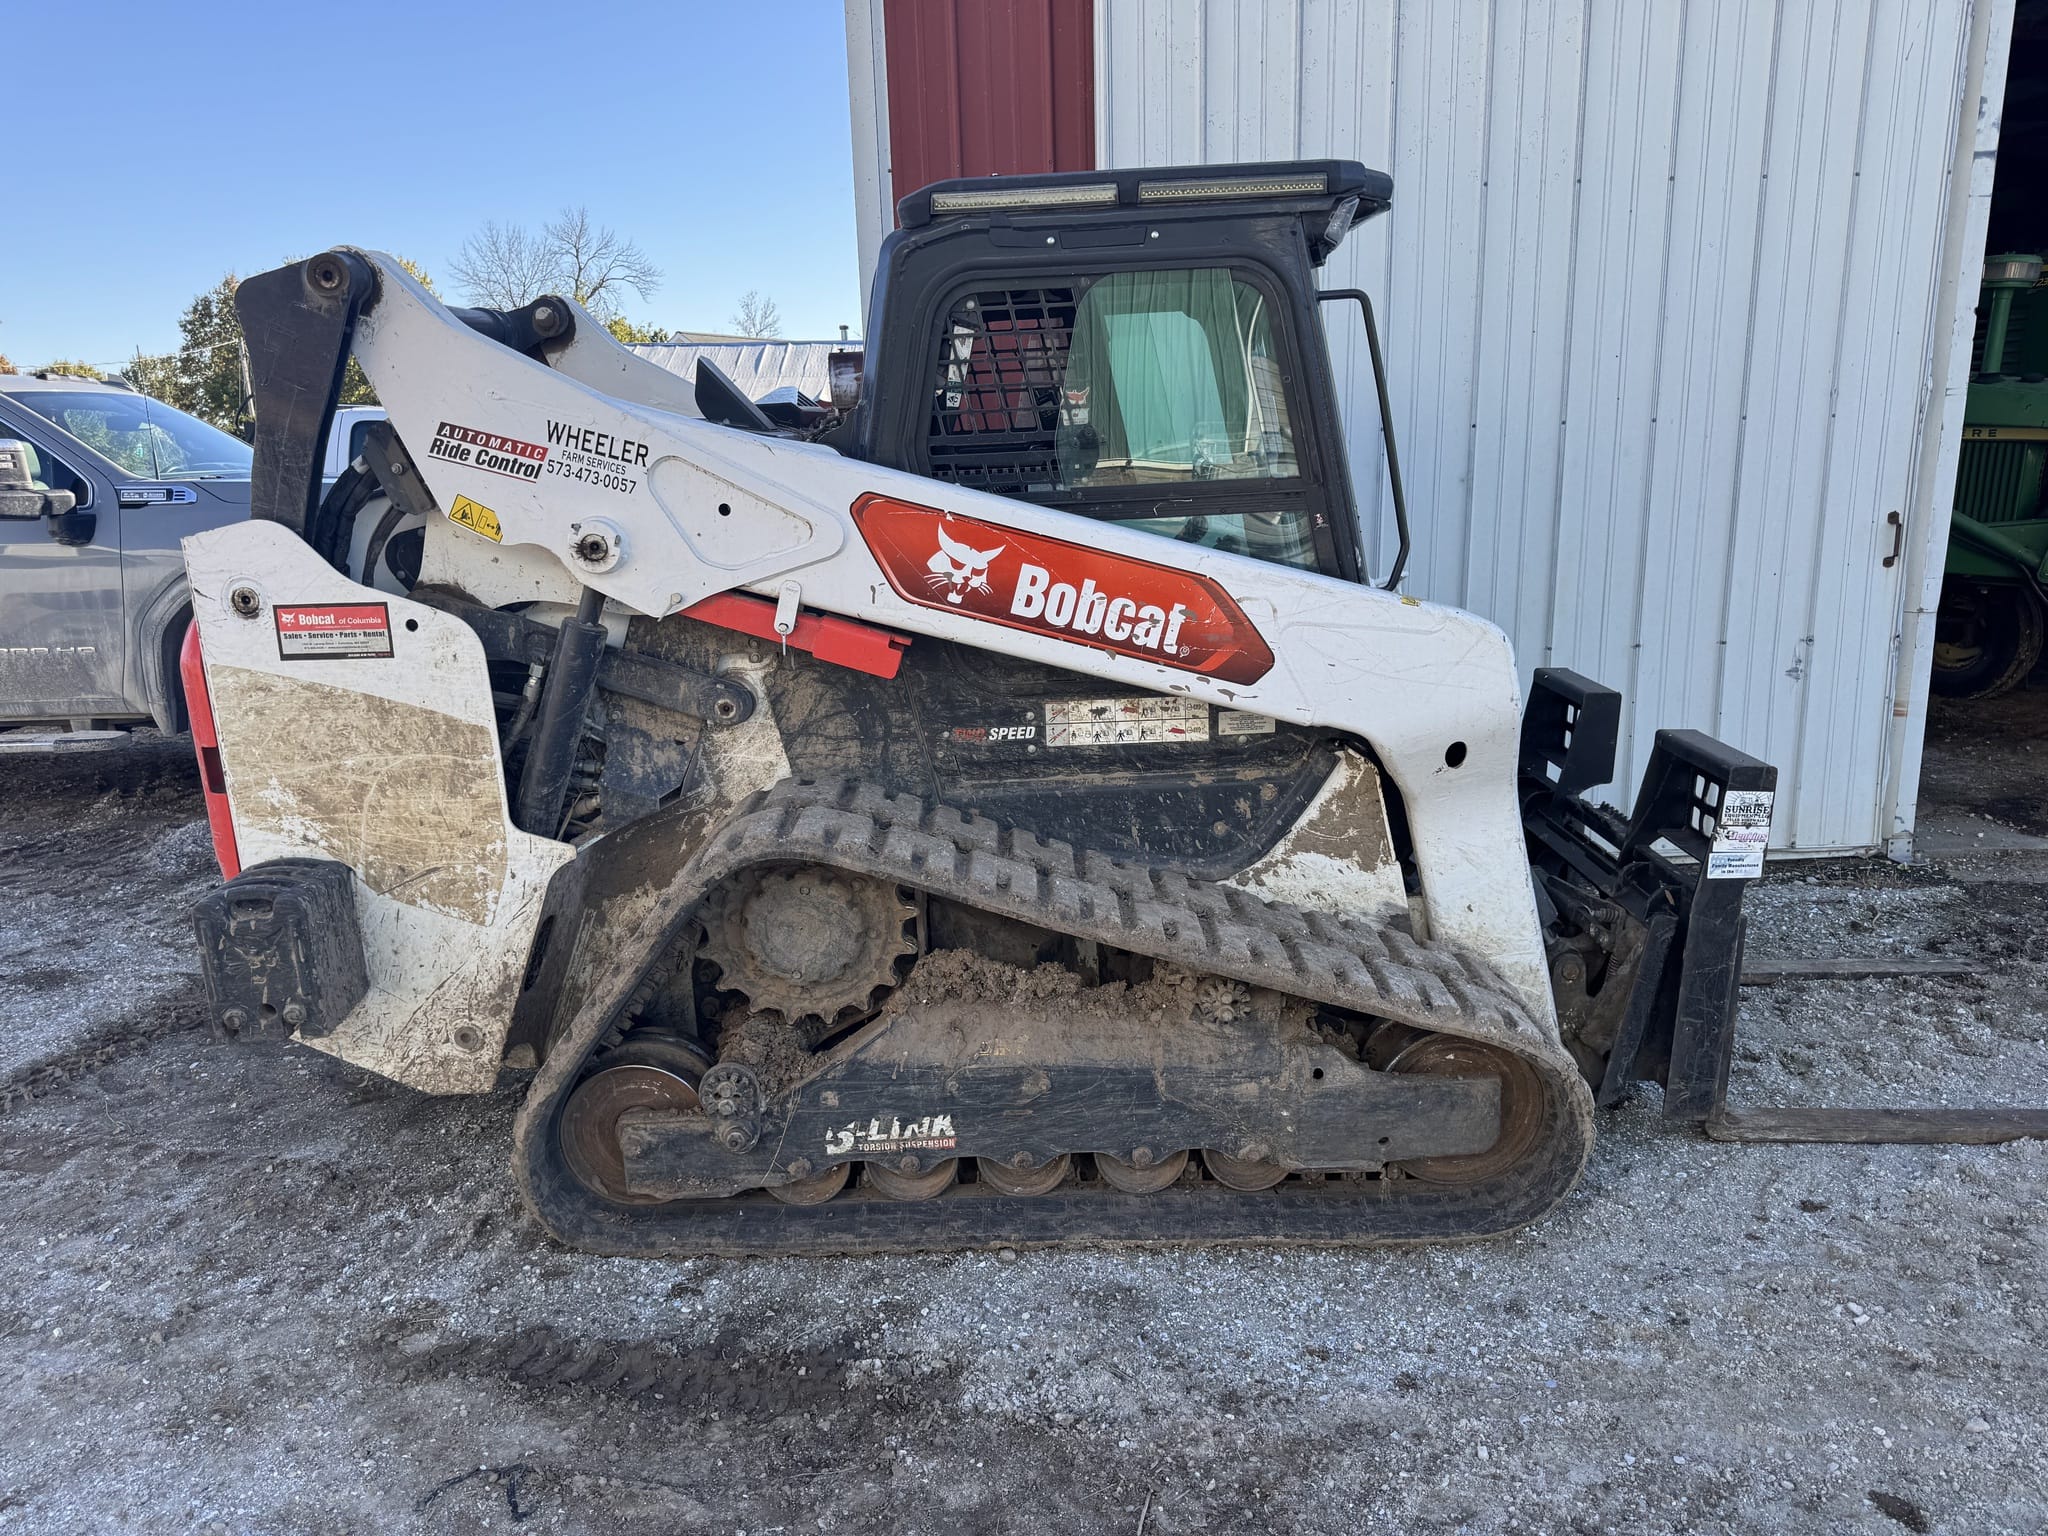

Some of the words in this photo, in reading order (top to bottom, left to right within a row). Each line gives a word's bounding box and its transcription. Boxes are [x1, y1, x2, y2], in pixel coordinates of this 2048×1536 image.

[440, 424, 544, 459] AUTOMATIC
[547, 420, 649, 467] WHEELER
[429, 437, 470, 462] Ride
[475, 449, 543, 479] Control
[561, 450, 585, 464] FARM
[586, 456, 627, 475] SERVICES
[546, 459, 637, 494] 573-473-0057
[298, 613, 336, 625] Bobcat
[347, 616, 382, 624] Columbia
[1010, 562, 1187, 654] Bobcat
[283, 632, 303, 640] Sales
[308, 631, 334, 639] Service
[363, 630, 385, 638] Rental
[988, 726, 1036, 740] SPEED
[1725, 805, 1770, 814] SUNRISE
[858, 1142, 897, 1152] TORSION
[899, 1138, 956, 1151] SUSPENSION
